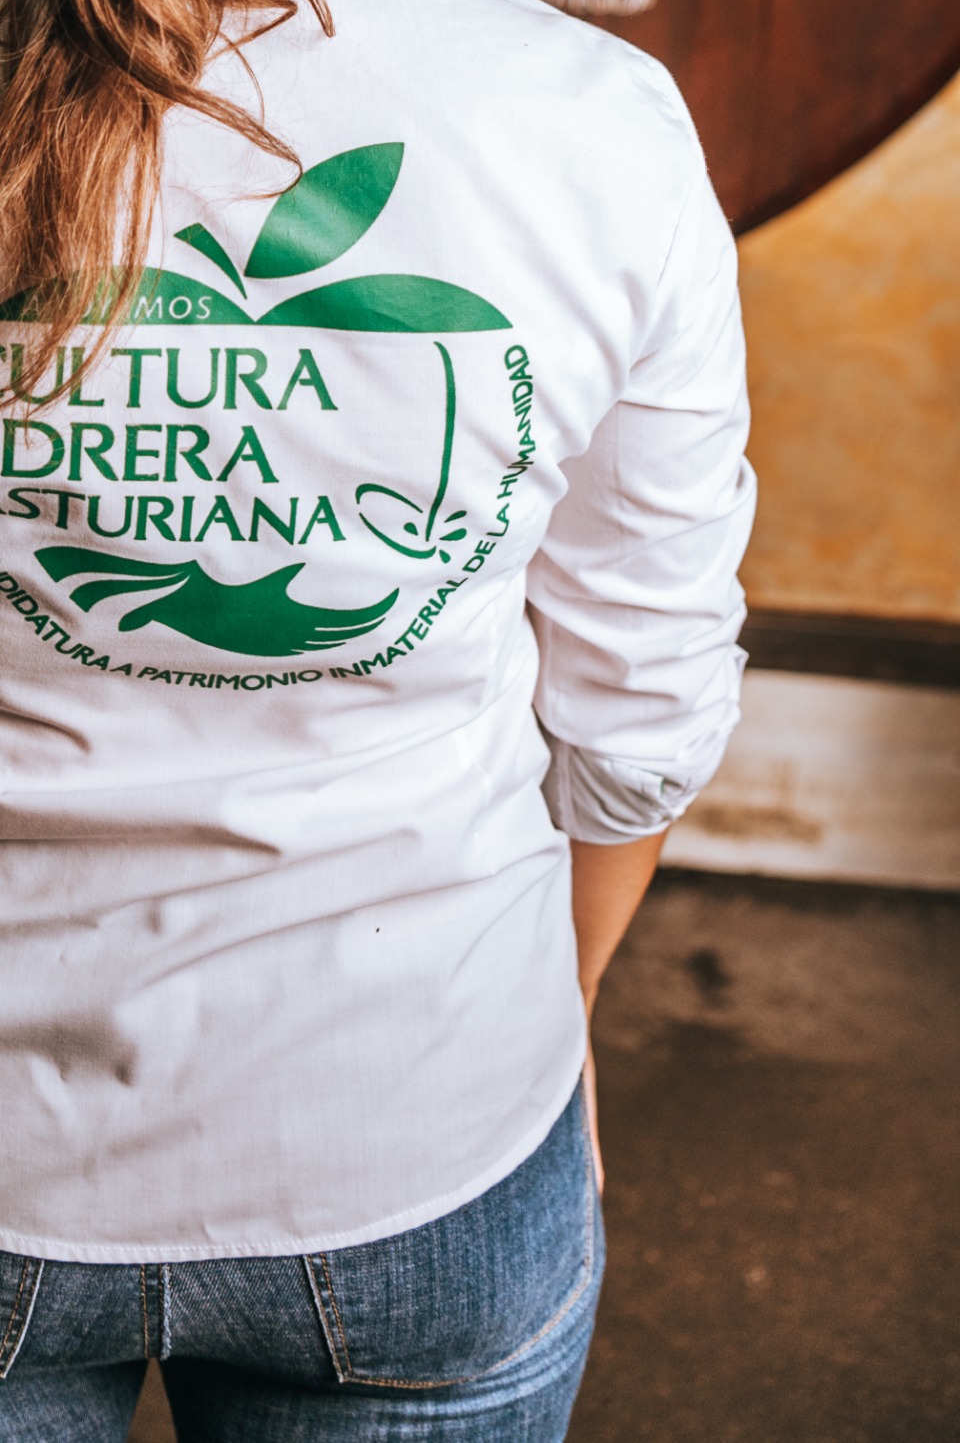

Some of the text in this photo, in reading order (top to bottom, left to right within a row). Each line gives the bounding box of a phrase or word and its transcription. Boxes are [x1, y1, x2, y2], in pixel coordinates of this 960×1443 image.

[496, 345, 536, 499] HUMANIDAD
[486, 503, 510, 537] LA
[462, 539, 497, 573] DE
[329, 577, 469, 679] INMATERIAL
[109, 663, 132, 676] A
[137, 666, 323, 691] PATRIMONIO
